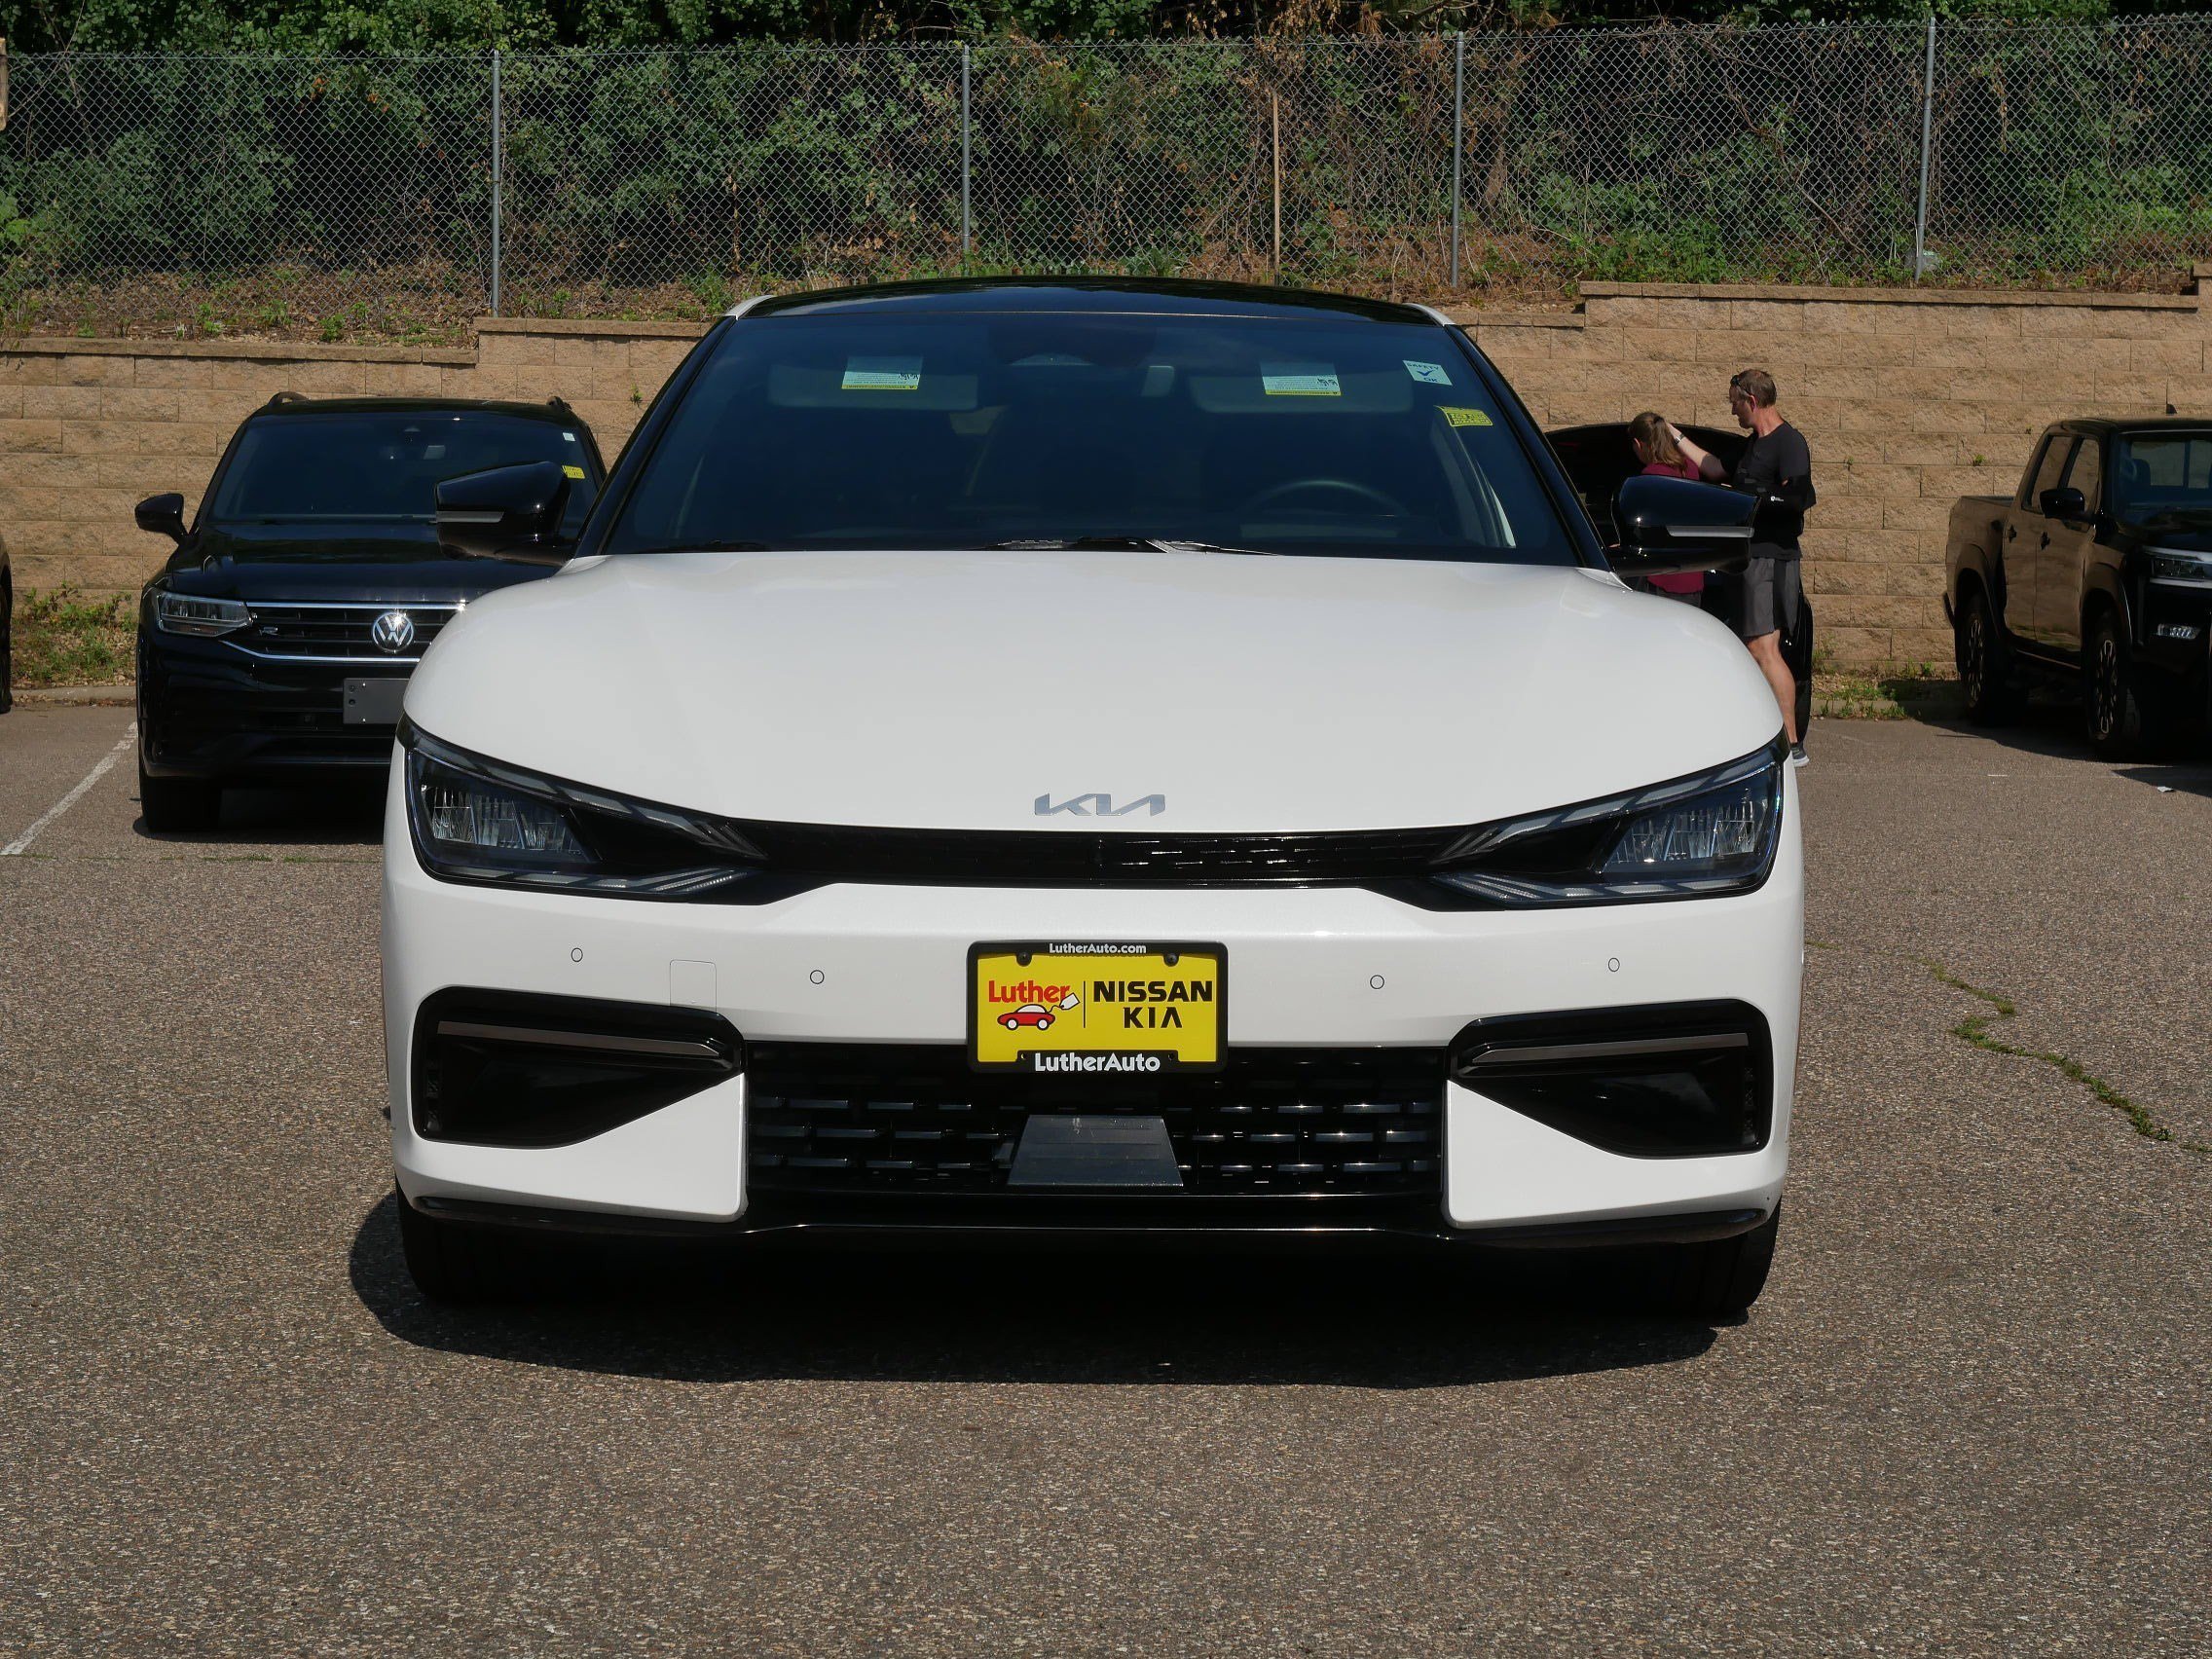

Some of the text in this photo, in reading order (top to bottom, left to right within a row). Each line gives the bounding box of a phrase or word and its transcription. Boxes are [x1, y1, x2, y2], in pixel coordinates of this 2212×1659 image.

[1034, 793, 1166, 817] KIA
[1049, 942, 1147, 954] LutherAuto.com
[988, 979, 1071, 1004] Luther
[1093, 980, 1213, 1002] NISSAN
[1124, 1006, 1183, 1029] KIA
[1035, 1052, 1161, 1072] LutherAuto
